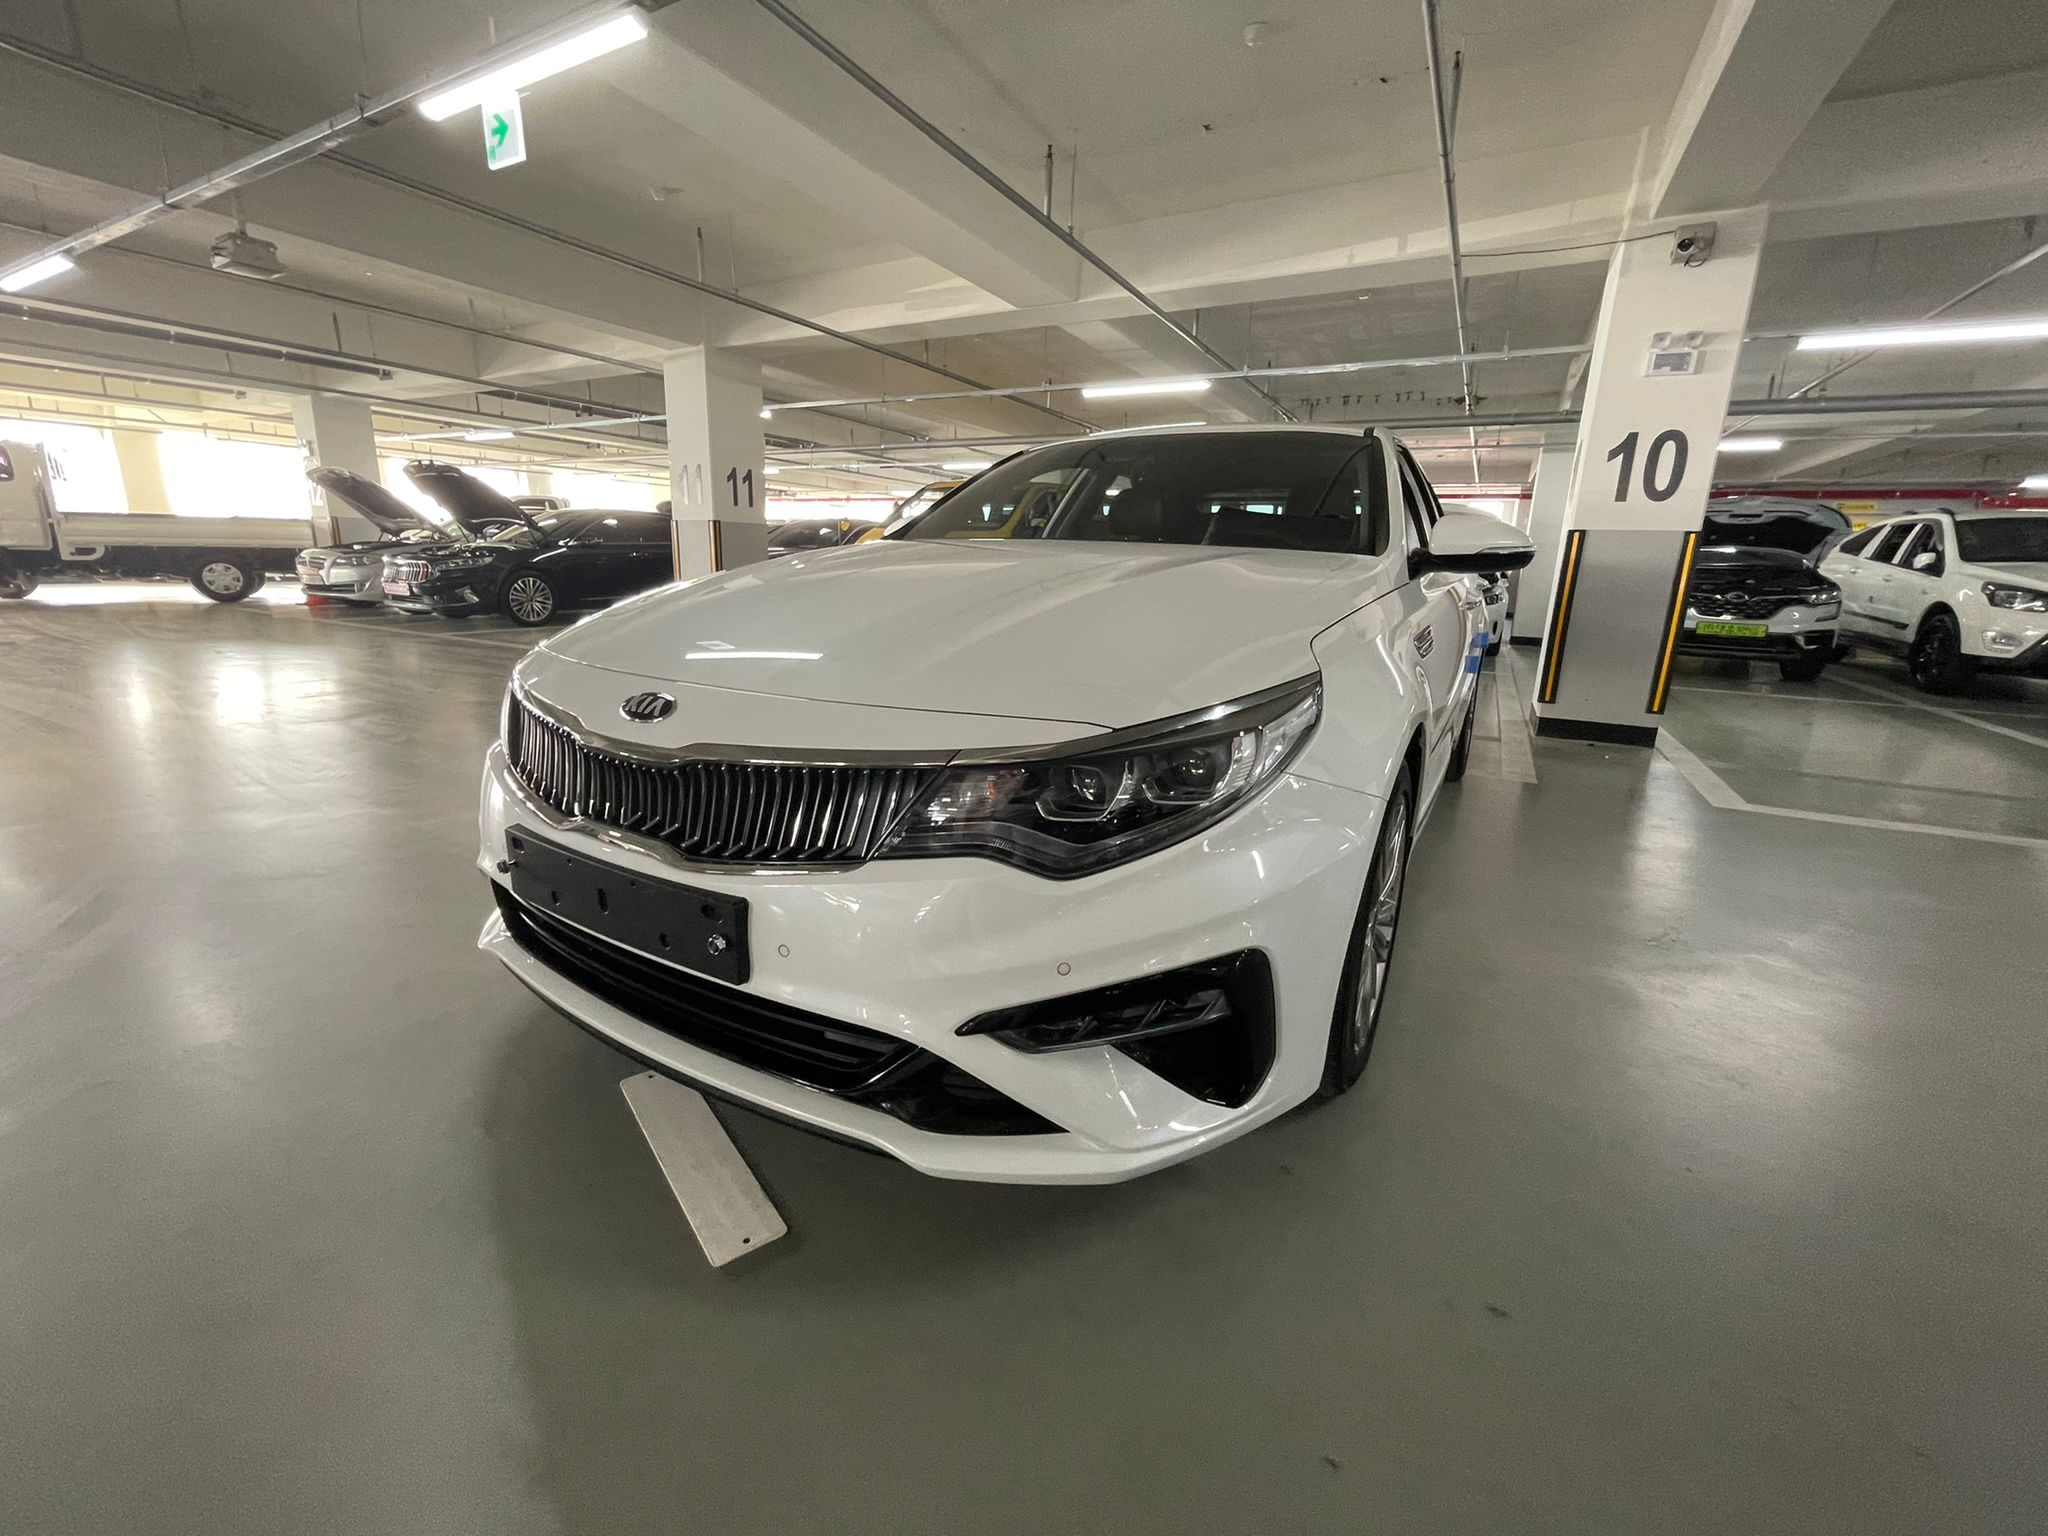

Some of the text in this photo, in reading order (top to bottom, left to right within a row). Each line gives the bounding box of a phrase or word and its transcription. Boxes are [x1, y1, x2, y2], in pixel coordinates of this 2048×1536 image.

[677, 463, 704, 505] 11
[727, 466, 754, 508] 11
[1607, 429, 1689, 503] 10
[622, 694, 668, 717] KIA
